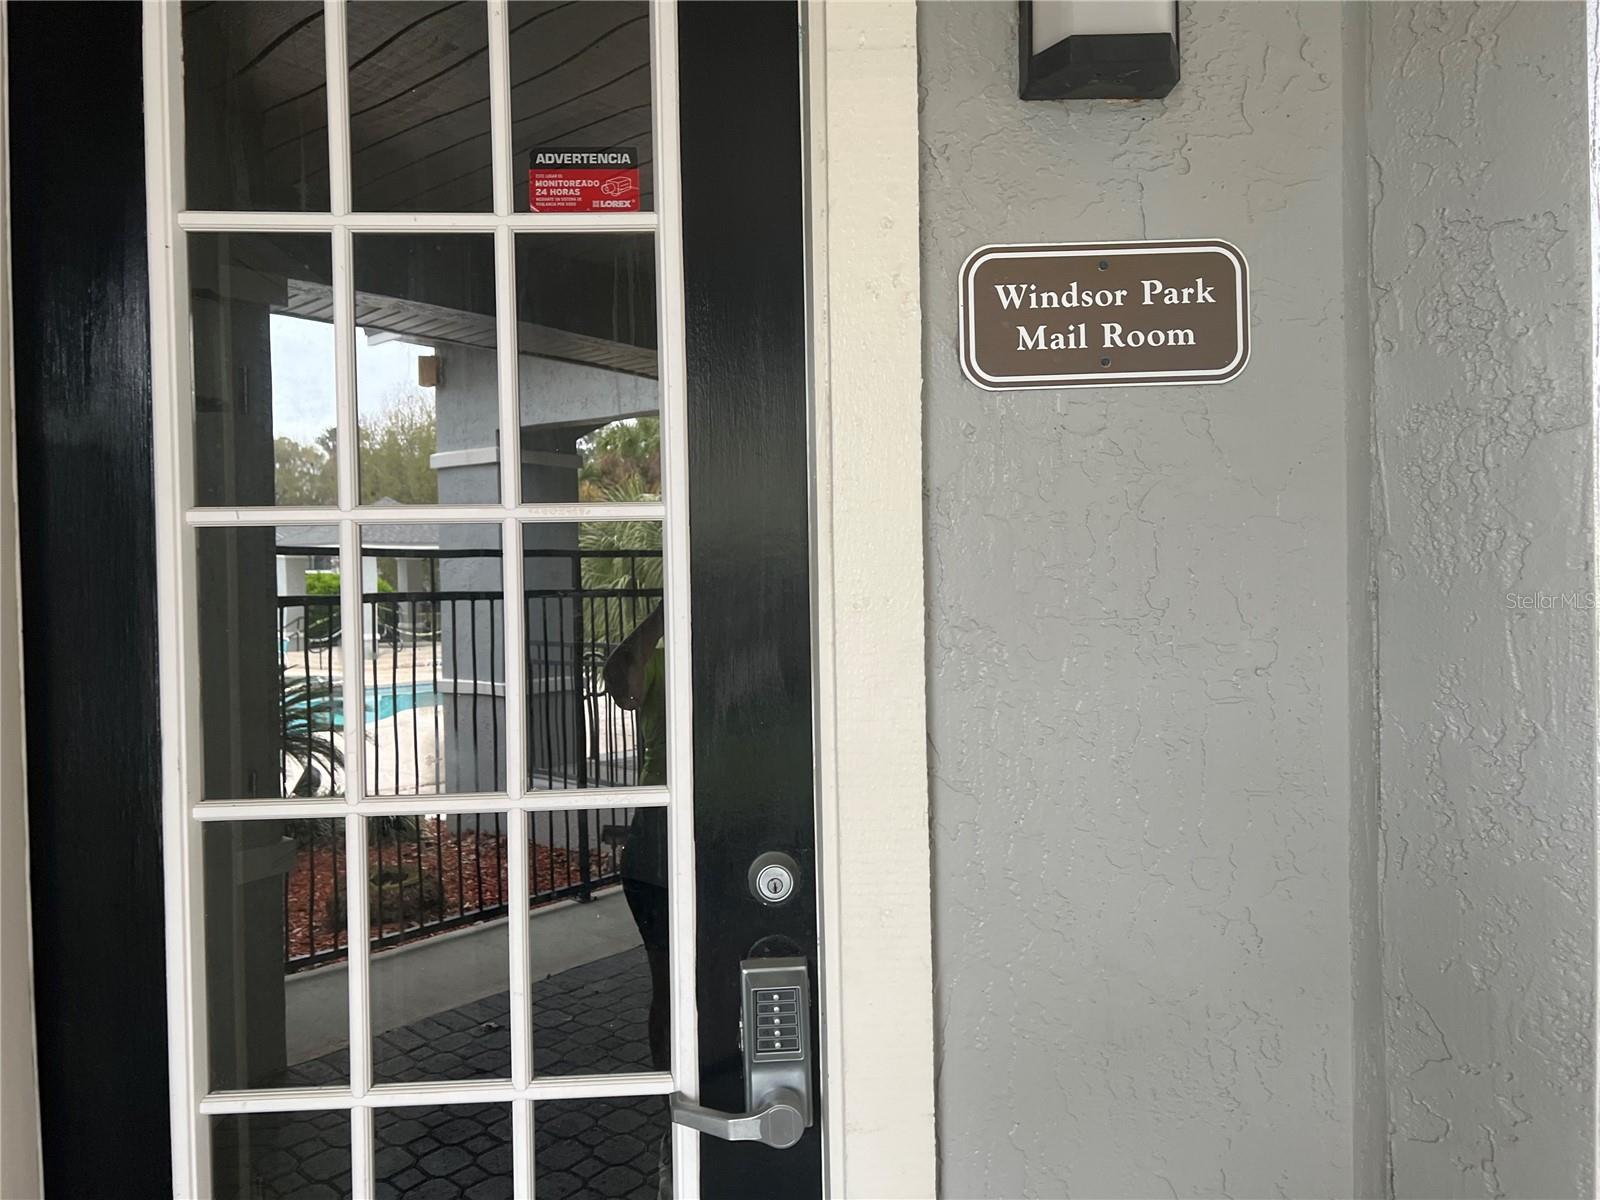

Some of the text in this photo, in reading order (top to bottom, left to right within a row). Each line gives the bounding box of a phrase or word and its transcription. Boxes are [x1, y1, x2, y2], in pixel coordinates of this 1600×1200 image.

[536, 153, 631, 164] ADVERTENCIA
[535, 188, 581, 196] 24 HORAS
[600, 200, 631, 208] LOREX
[994, 277, 1217, 310] Windsor Park
[1016, 322, 1196, 351] Mail Room
